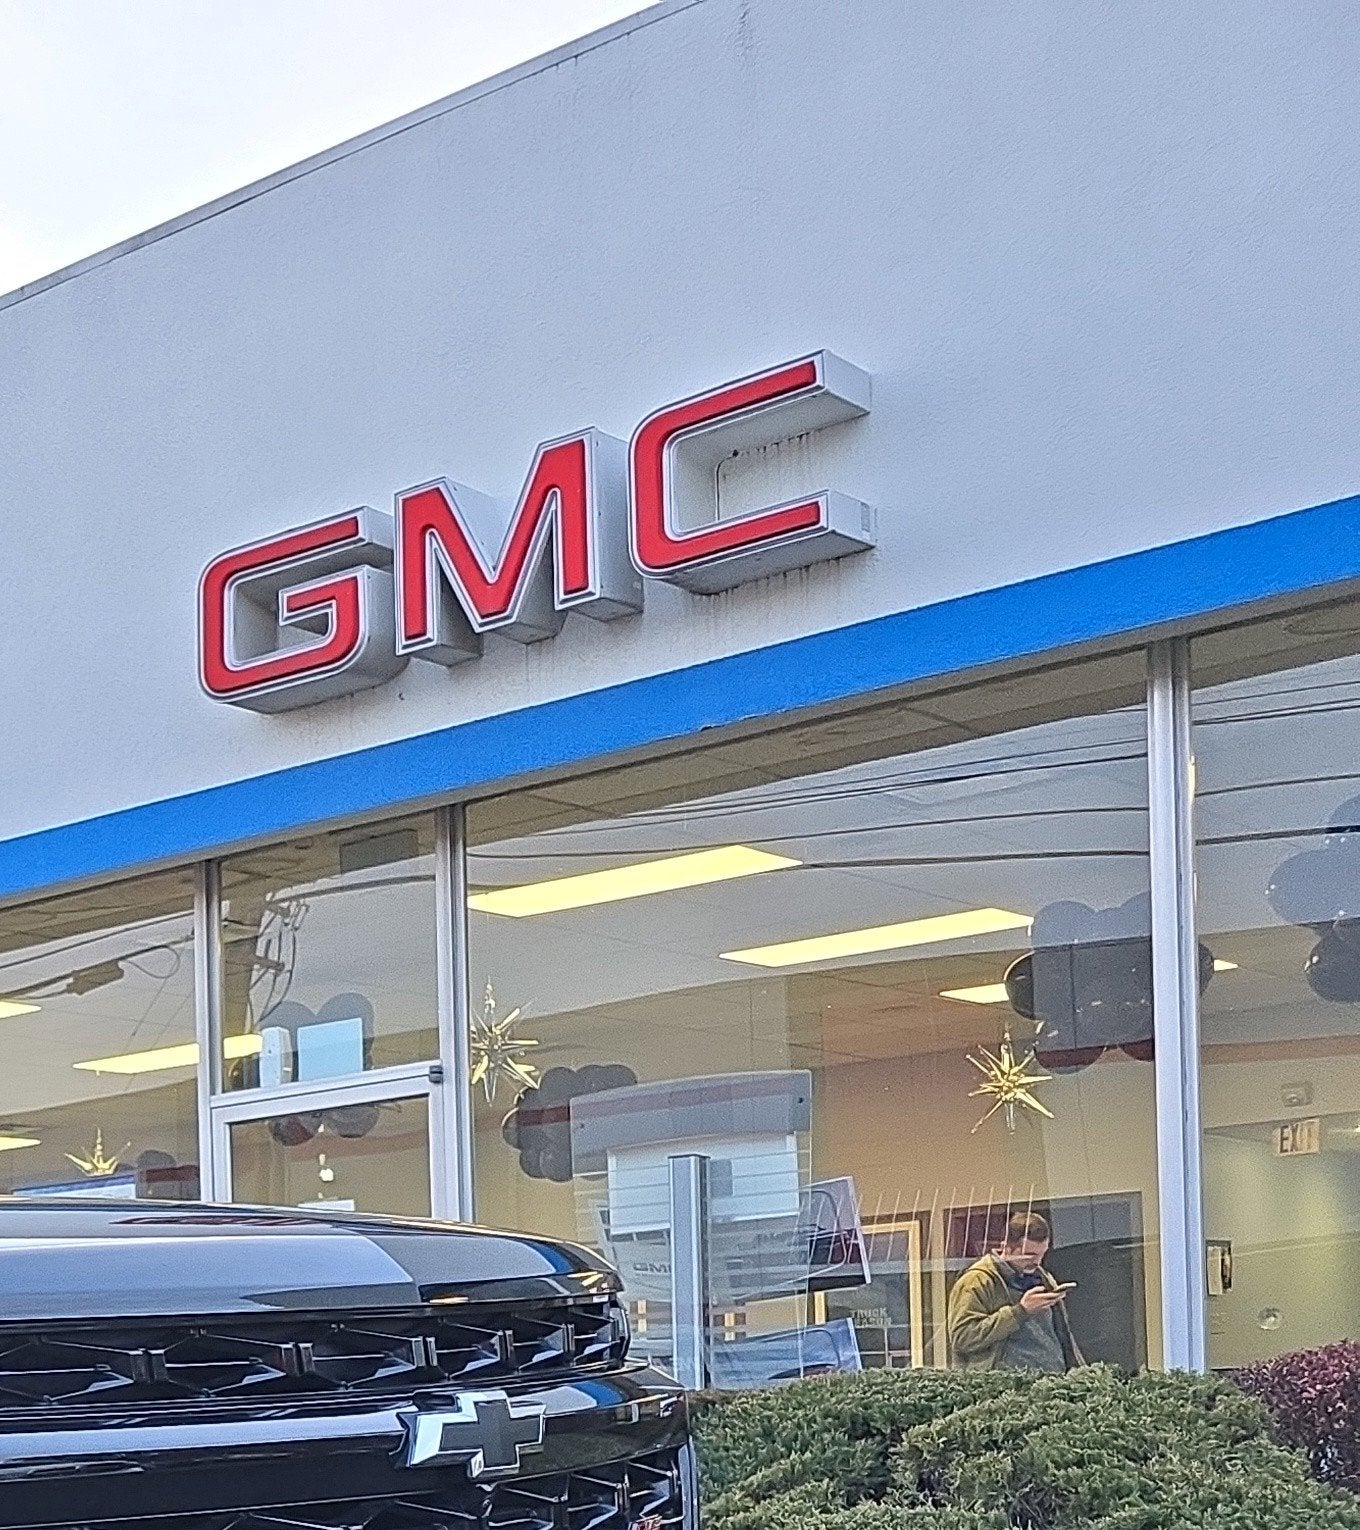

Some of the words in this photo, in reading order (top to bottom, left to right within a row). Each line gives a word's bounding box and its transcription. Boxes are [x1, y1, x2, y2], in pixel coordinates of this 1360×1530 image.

[198, 349, 868, 708] GMC
[1280, 1122, 1315, 1154] EXIT
[851, 1307, 888, 1319] TRUCK
